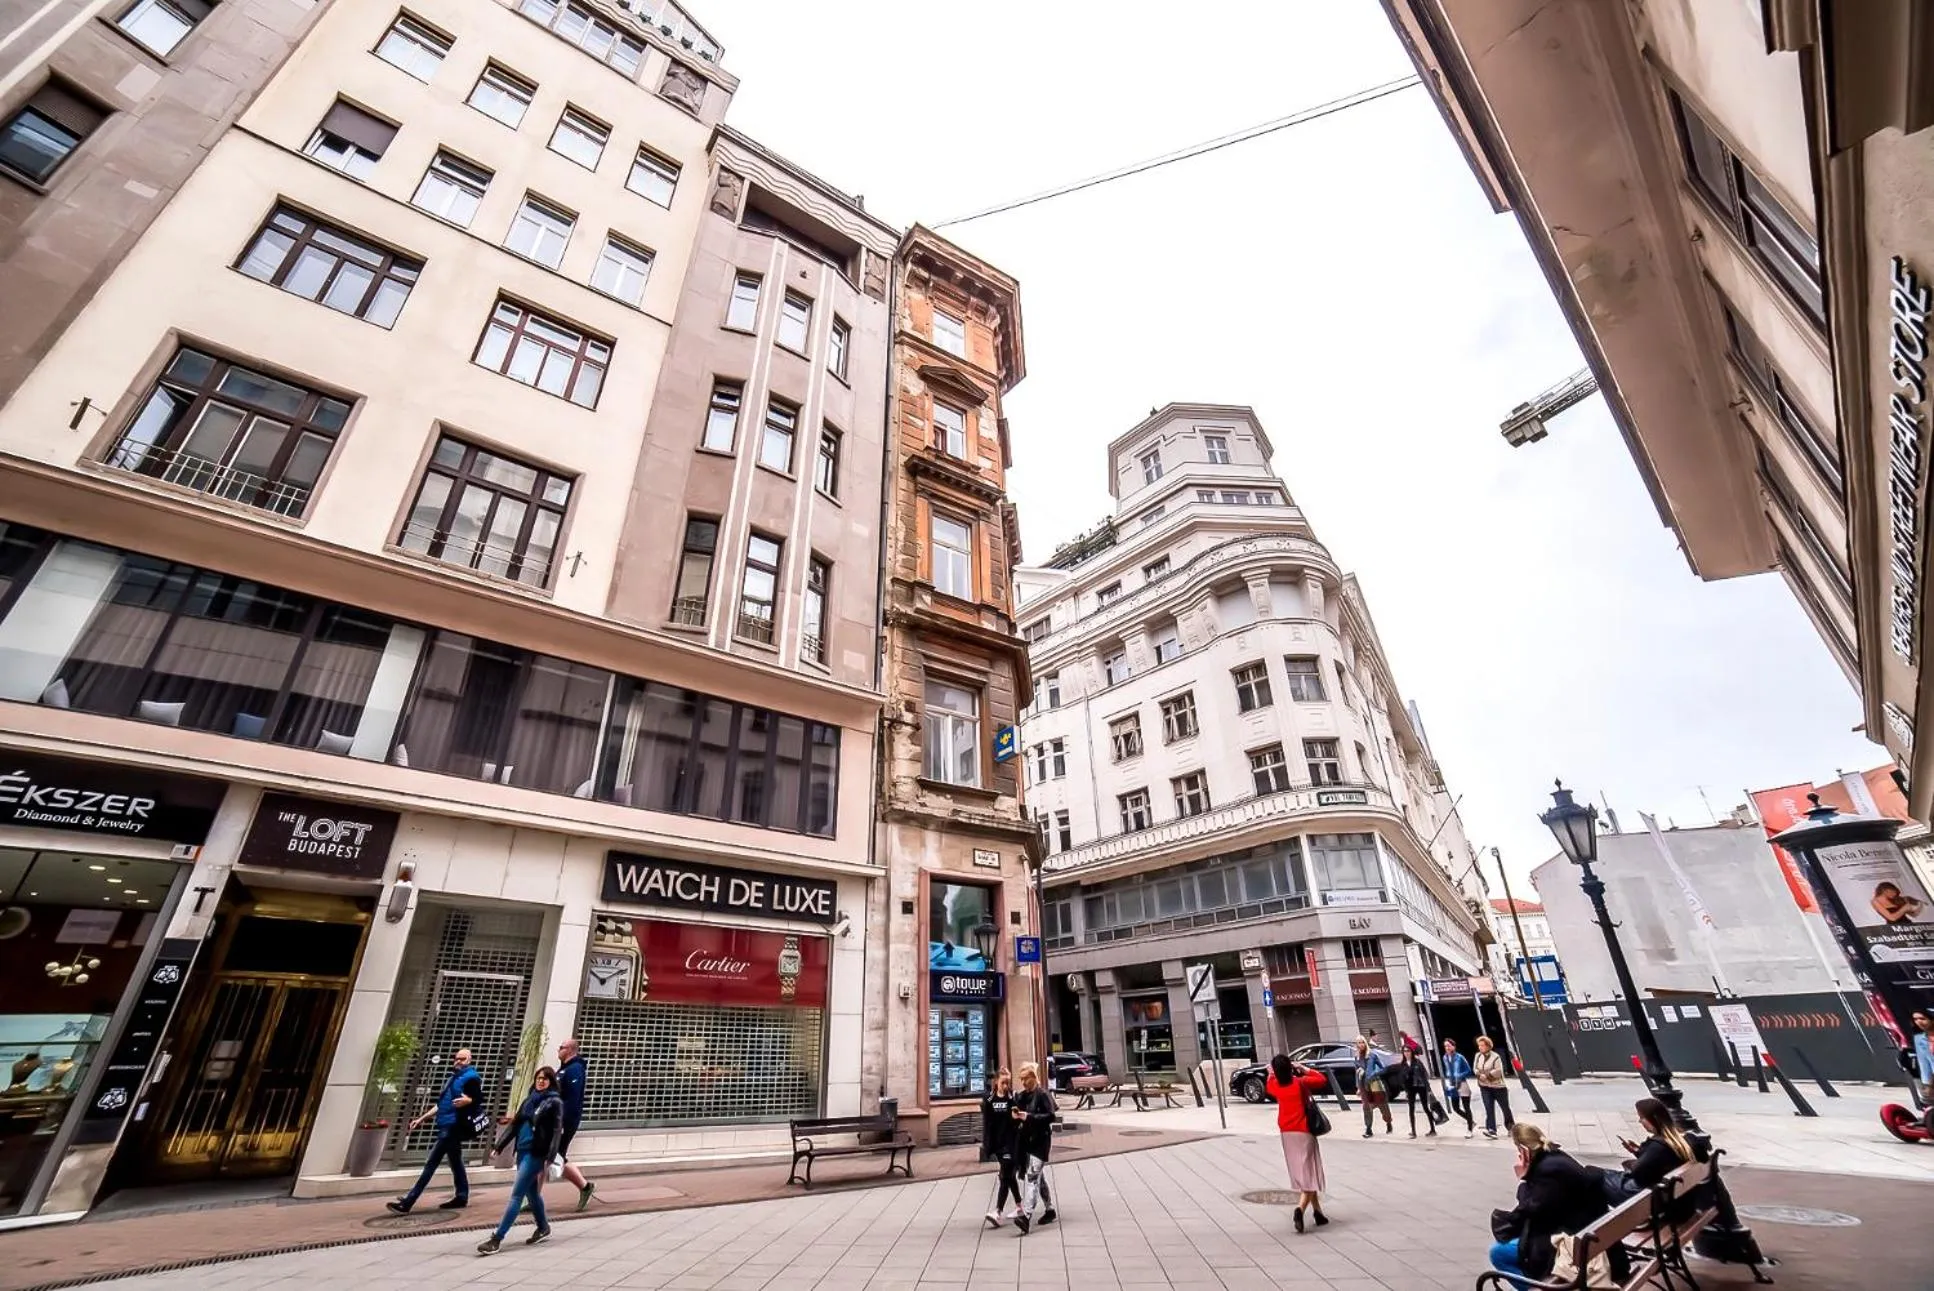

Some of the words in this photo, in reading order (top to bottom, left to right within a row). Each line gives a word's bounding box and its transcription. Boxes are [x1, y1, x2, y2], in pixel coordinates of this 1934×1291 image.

[1889, 255, 1929, 405] STORE
[1888, 392, 1922, 562] STREETWEAR
[13, 808, 81, 824] Diamond
[82, 815, 95, 826] &
[96, 817, 144, 833] Jewelry
[278, 812, 296, 823] THE
[292, 814, 373, 845] LOFT
[287, 838, 362, 859] BUDAPEST
[616, 863, 721, 904] WATCH
[728, 879, 765, 909] DE
[772, 885, 831, 916] LUXE
[685, 948, 751, 973] Cartier
